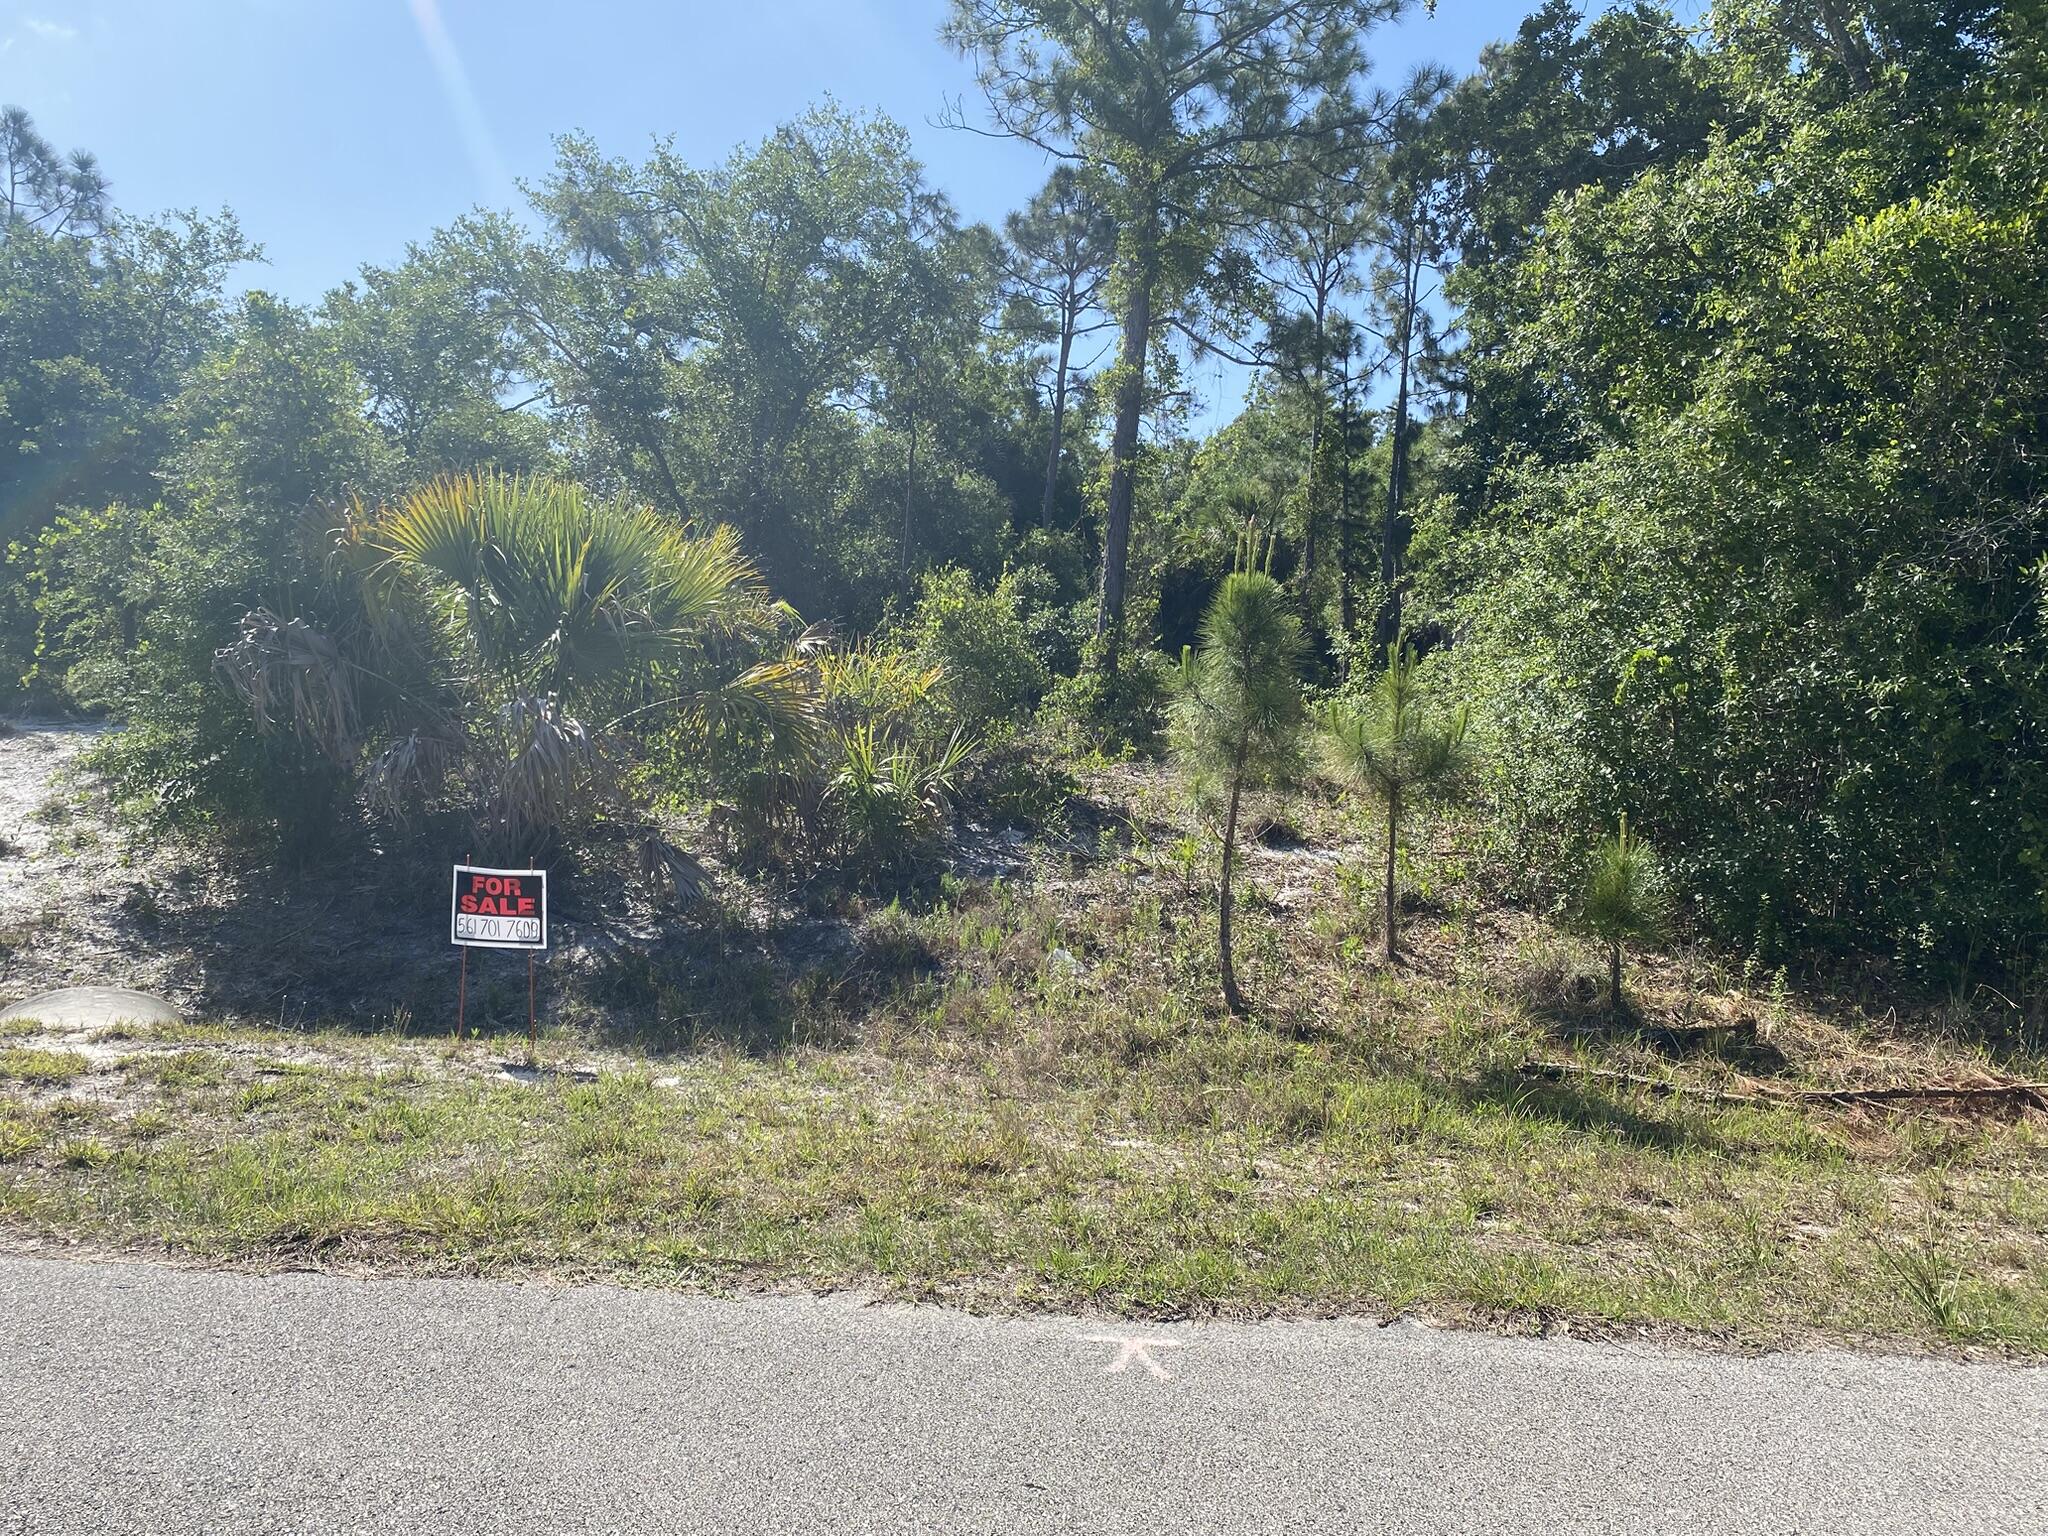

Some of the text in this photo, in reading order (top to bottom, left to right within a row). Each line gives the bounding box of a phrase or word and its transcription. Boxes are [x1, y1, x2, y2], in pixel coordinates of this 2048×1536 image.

[472, 876, 521, 896] FOR
[461, 895, 535, 915] SALE
[458, 917, 477, 936] 561
[480, 918, 501, 937] 701
